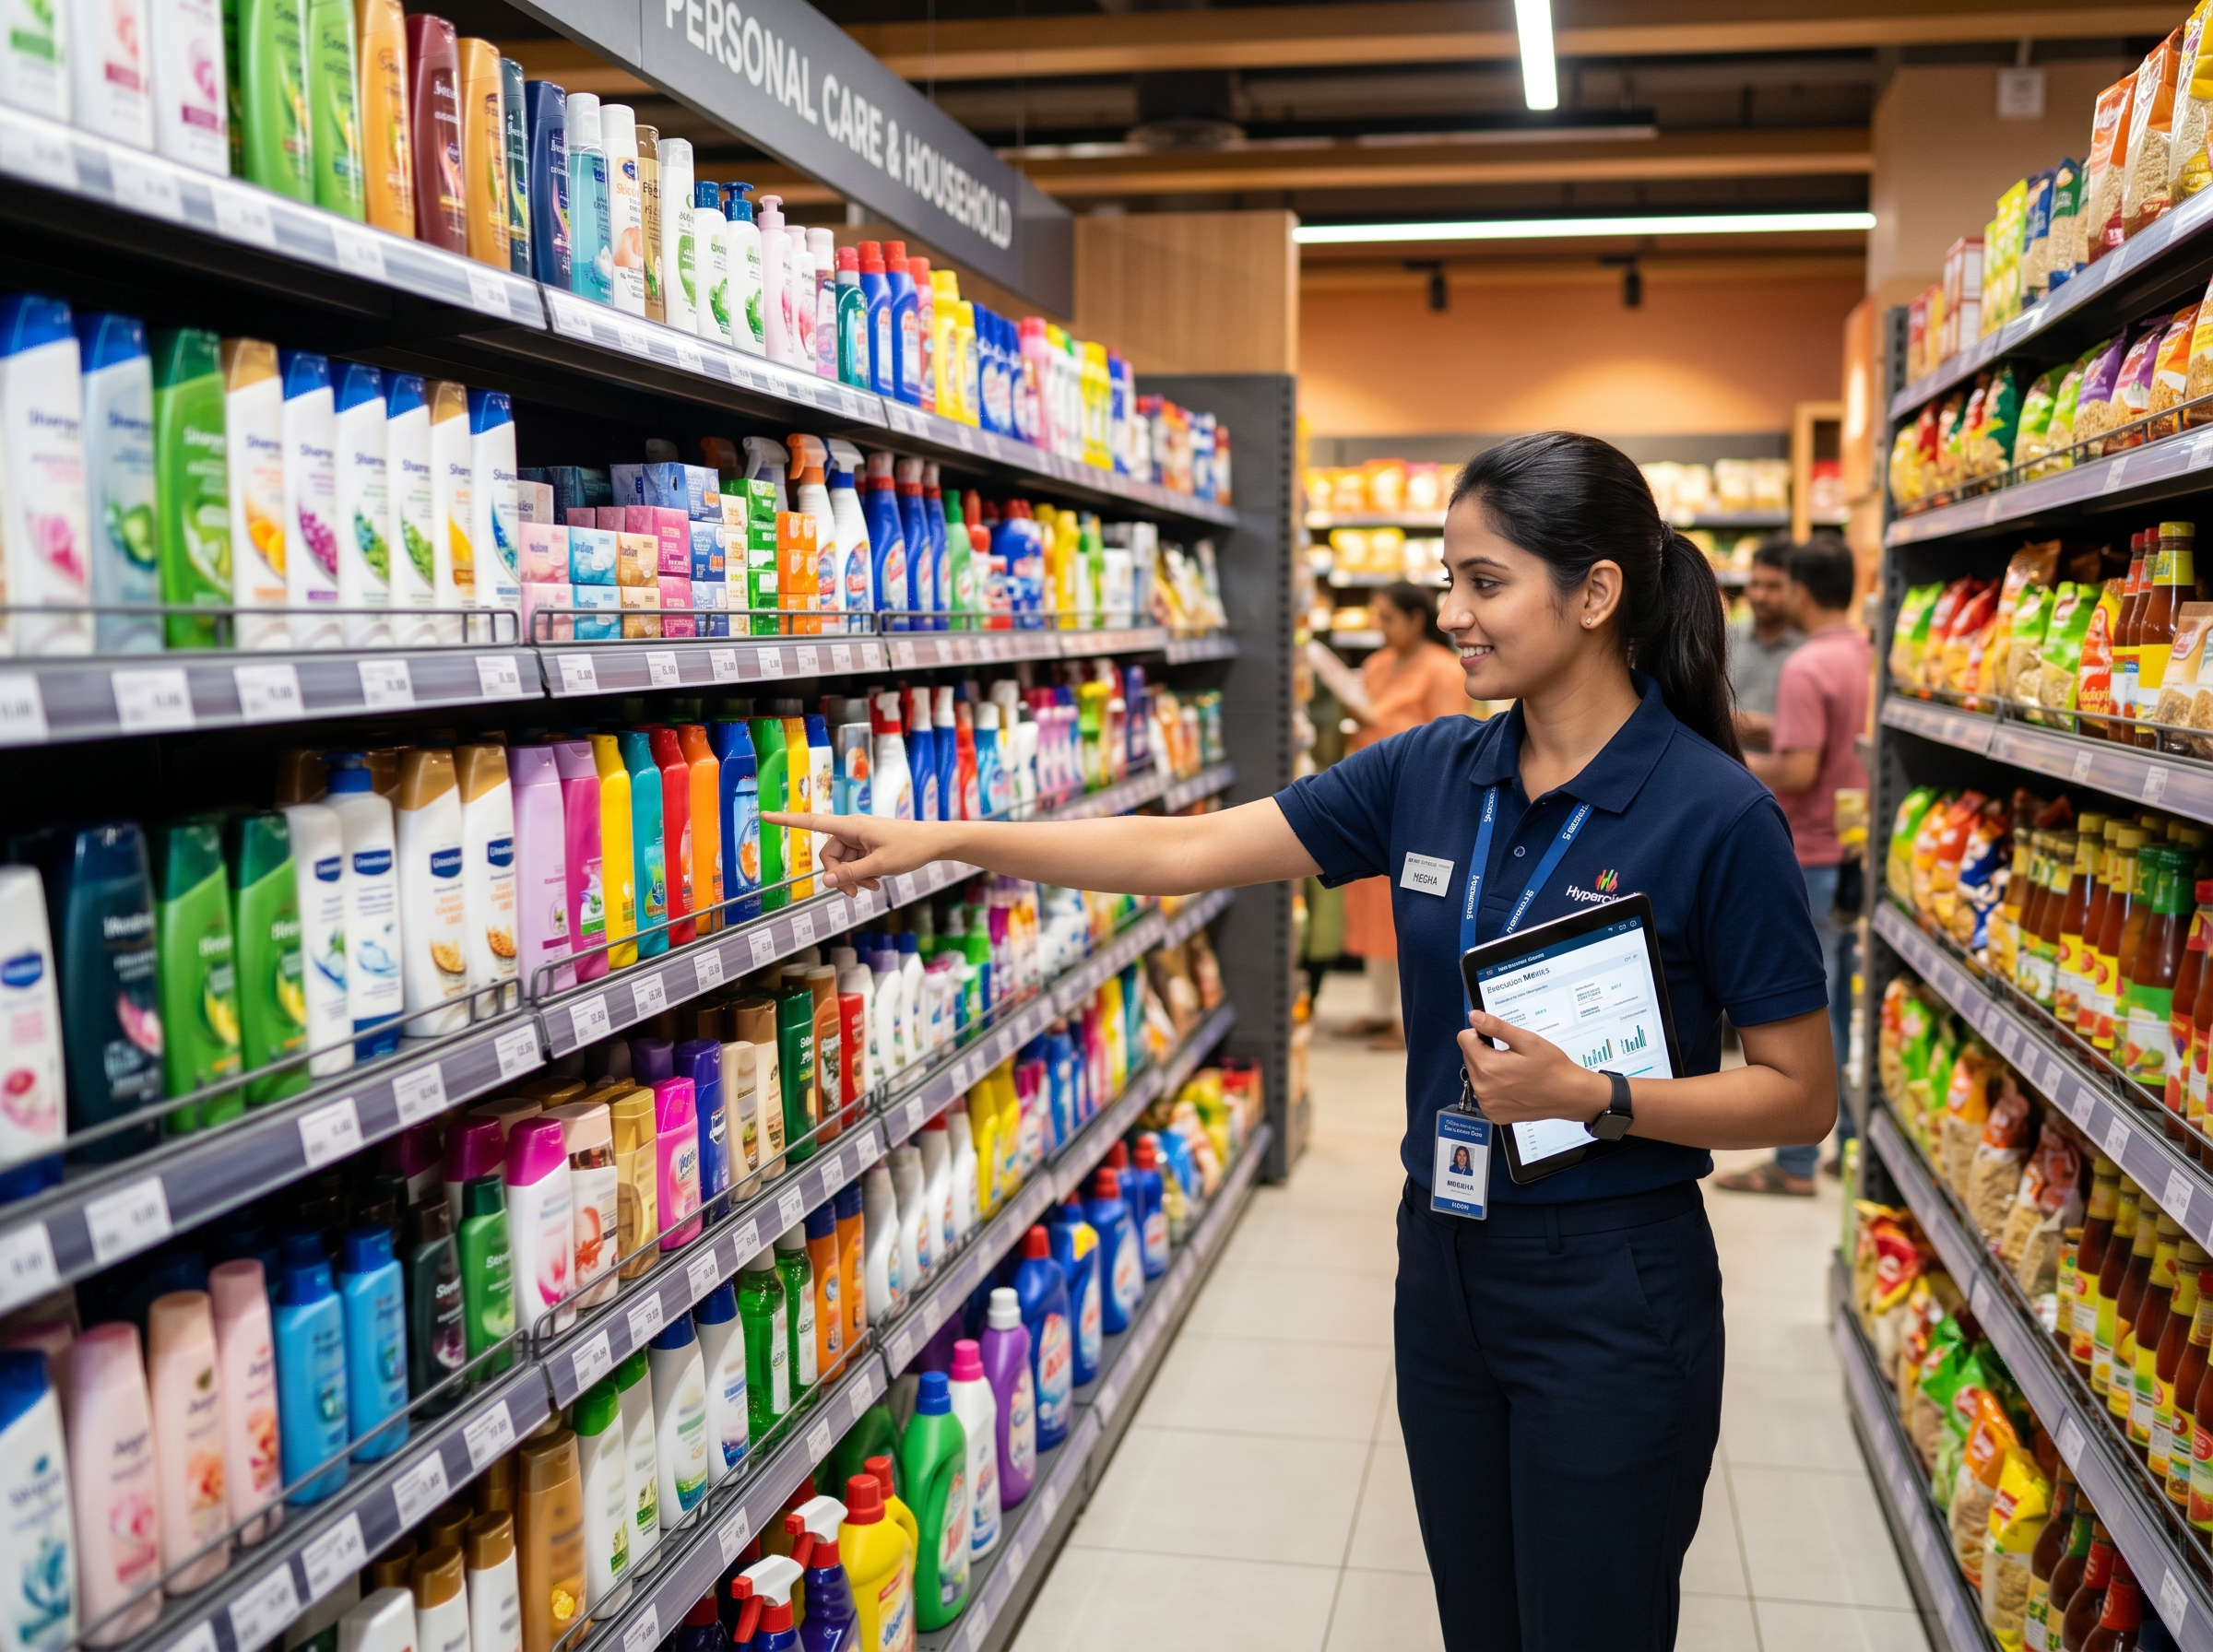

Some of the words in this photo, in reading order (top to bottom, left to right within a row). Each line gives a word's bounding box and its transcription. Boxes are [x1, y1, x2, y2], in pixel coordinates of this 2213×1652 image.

[822, 74, 883, 170] CARE
[886, 120, 902, 181] &
[905, 131, 1012, 250] HOUSEHOLD
[1413, 872, 1438, 885] MEGHA
